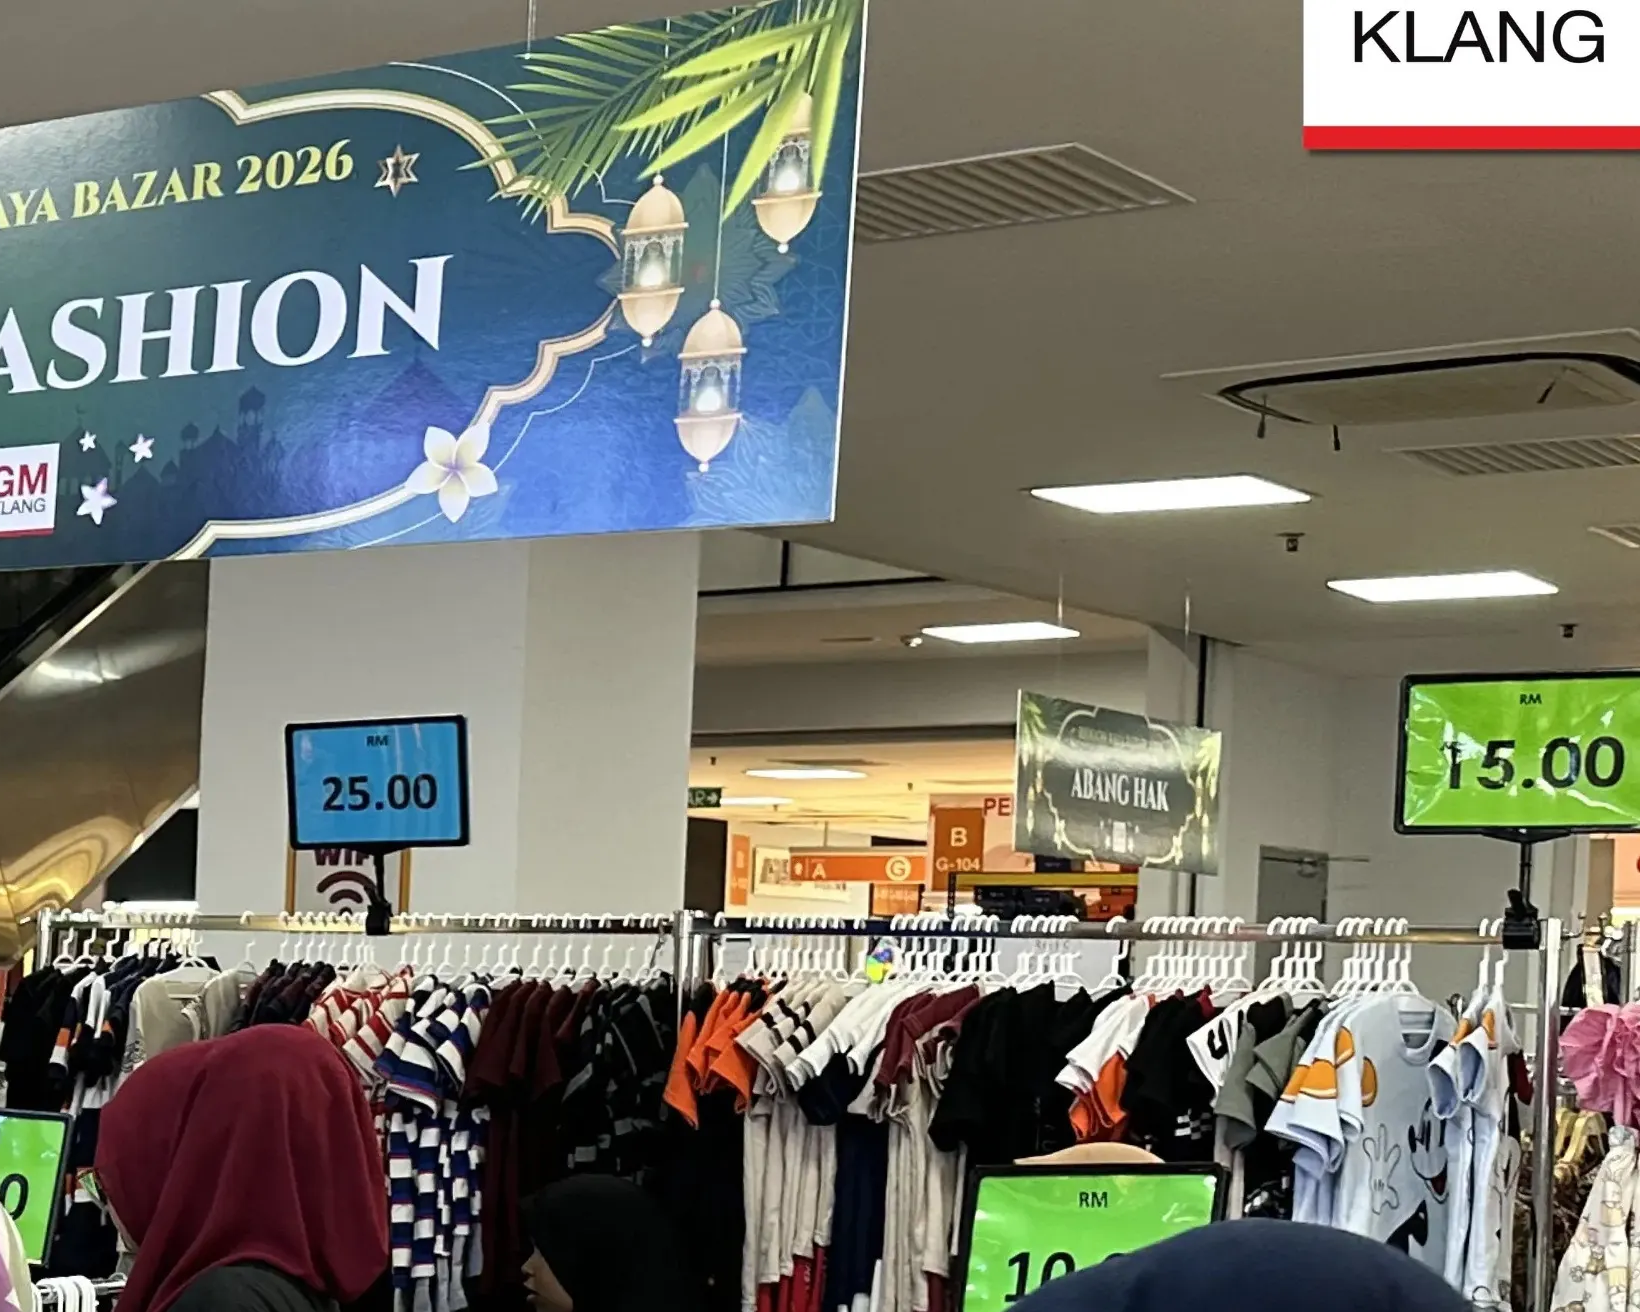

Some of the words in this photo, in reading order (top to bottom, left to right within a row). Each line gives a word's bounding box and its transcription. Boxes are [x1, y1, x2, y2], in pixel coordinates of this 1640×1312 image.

[71, 161, 224, 219] BAZAR
[235, 138, 354, 195] 2026
[1519, 693, 1543, 705] RM
[366, 735, 389, 747] RM
[1441, 735, 1622, 790] 15.00
[322, 773, 438, 812] 25.00
[1070, 767, 1130, 806] ABANG
[1133, 776, 1170, 812] HAK
[950, 826, 968, 847] B
[811, 863, 827, 880] A
[935, 857, 981, 872] G-104
[1079, 1191, 1108, 1208] RM
